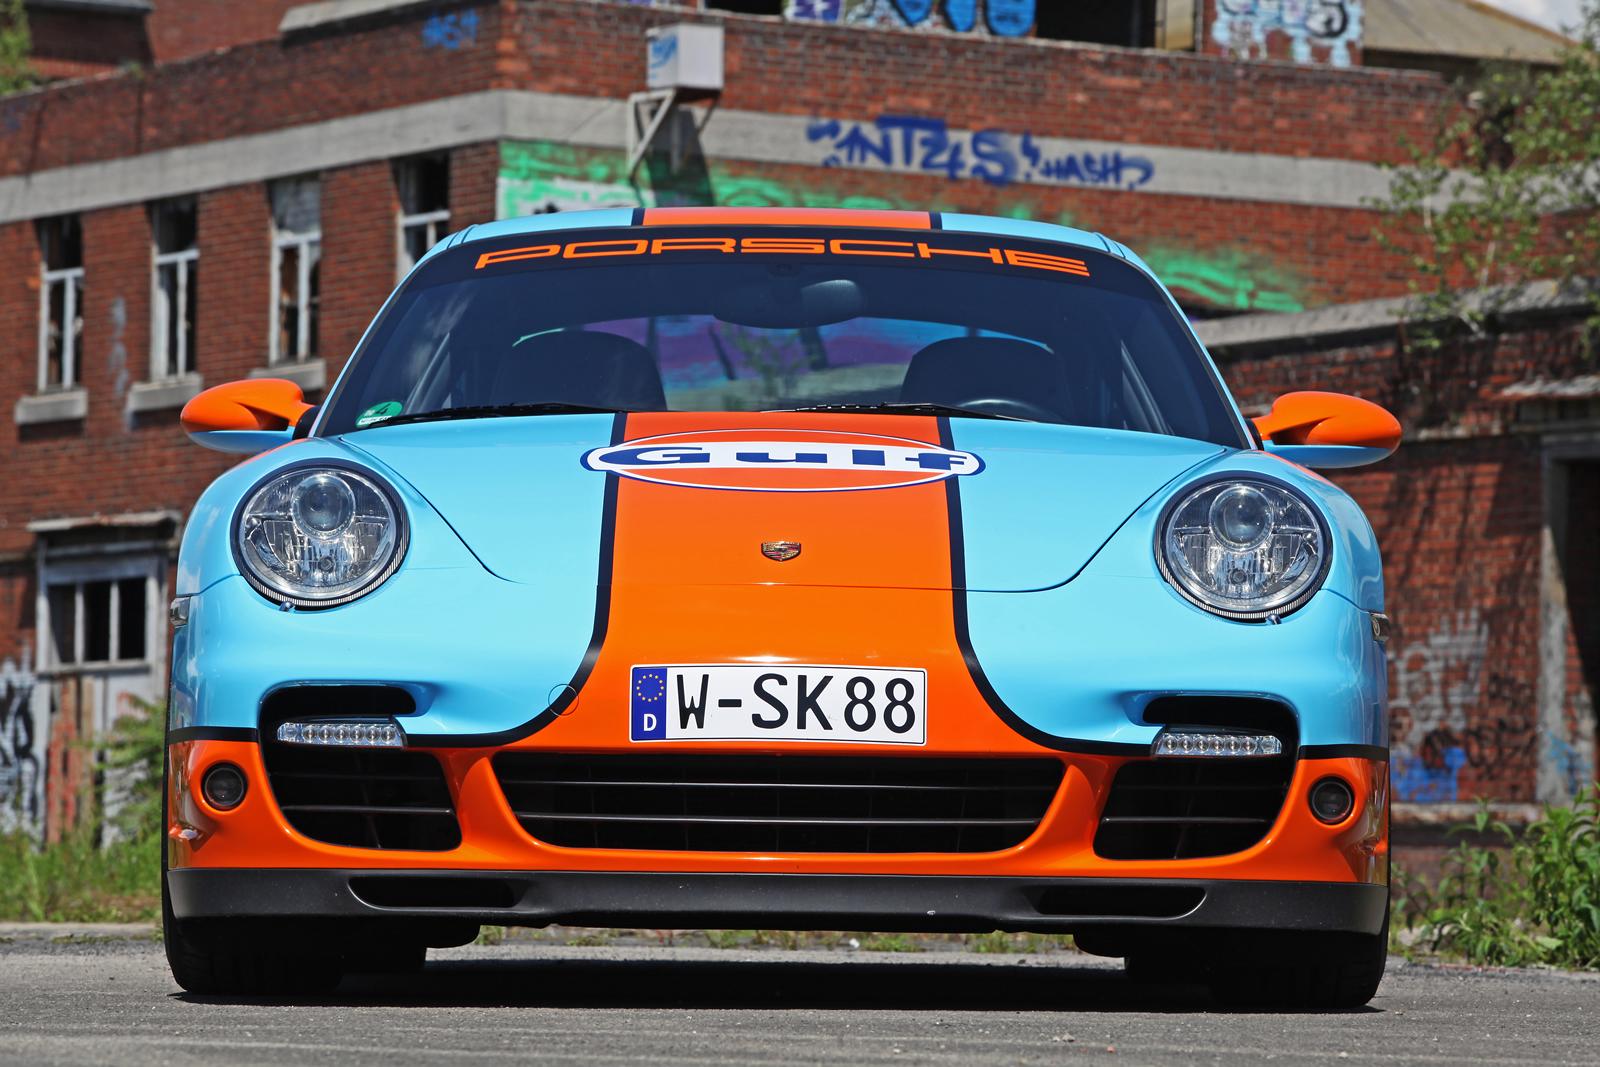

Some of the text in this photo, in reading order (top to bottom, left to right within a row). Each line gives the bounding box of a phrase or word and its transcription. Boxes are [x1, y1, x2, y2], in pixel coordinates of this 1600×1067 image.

[475, 237, 1090, 277] PORSCHE
[598, 446, 968, 471] Gulf
[643, 713, 657, 732] D
